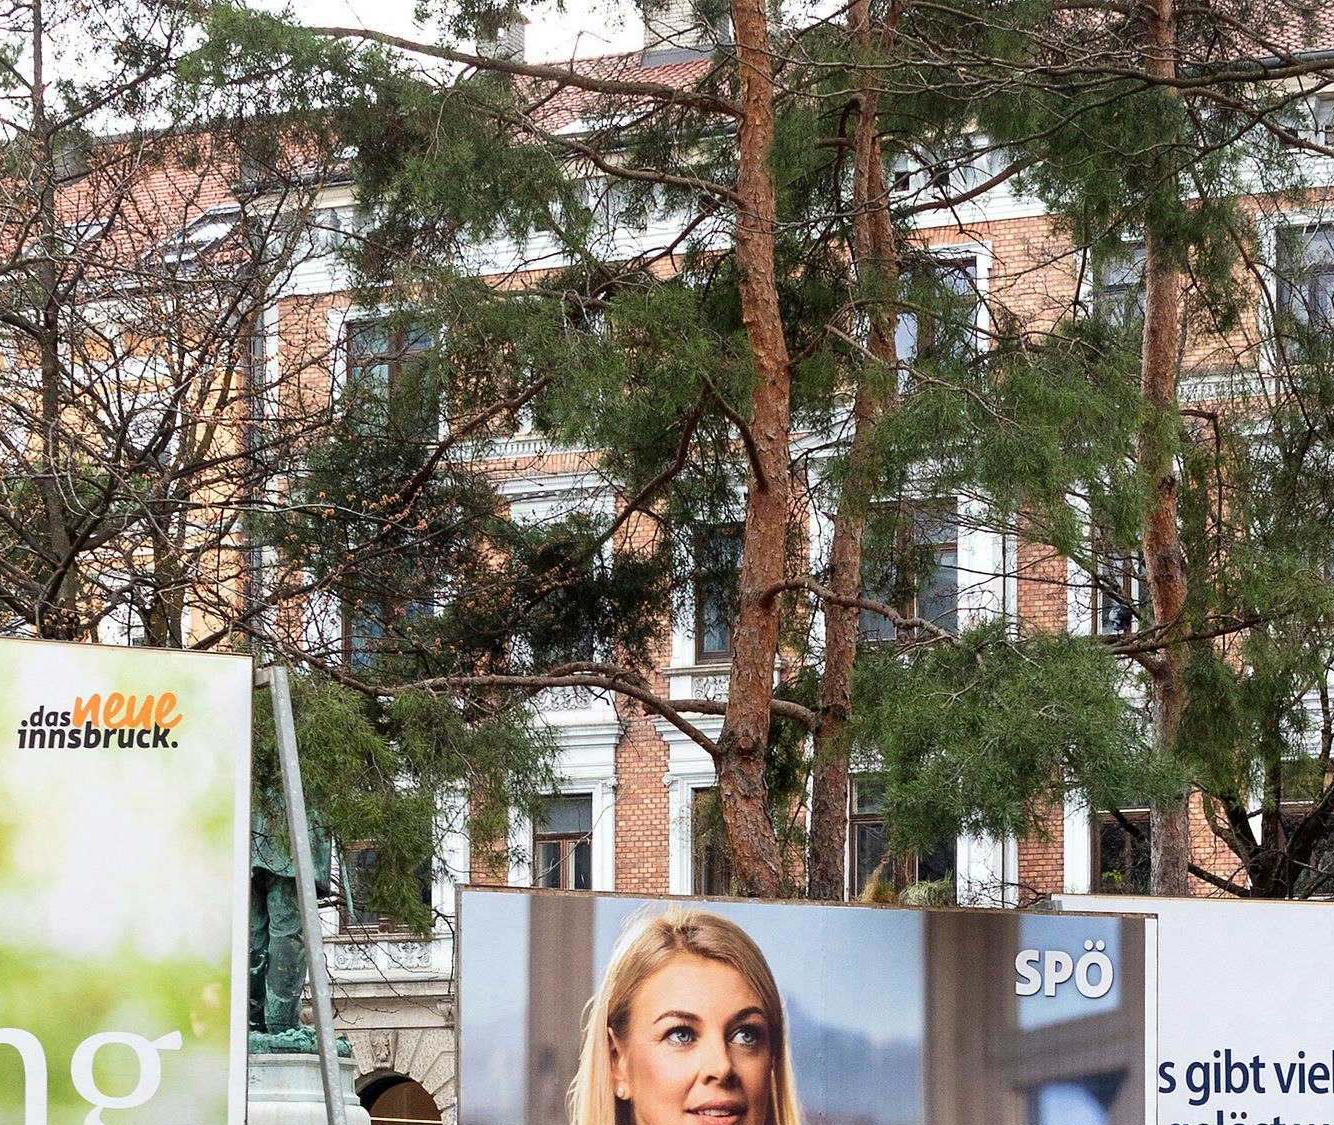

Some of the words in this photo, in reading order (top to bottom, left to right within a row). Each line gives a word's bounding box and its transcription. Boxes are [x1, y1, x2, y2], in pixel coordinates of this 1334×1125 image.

[72, 692, 183, 730] neue
[18, 721, 179, 749] innsbruck.
[1014, 939, 1114, 998] SPÖ
[1158, 1060, 1176, 1095] s
[1185, 1049, 1266, 1106] gibt
